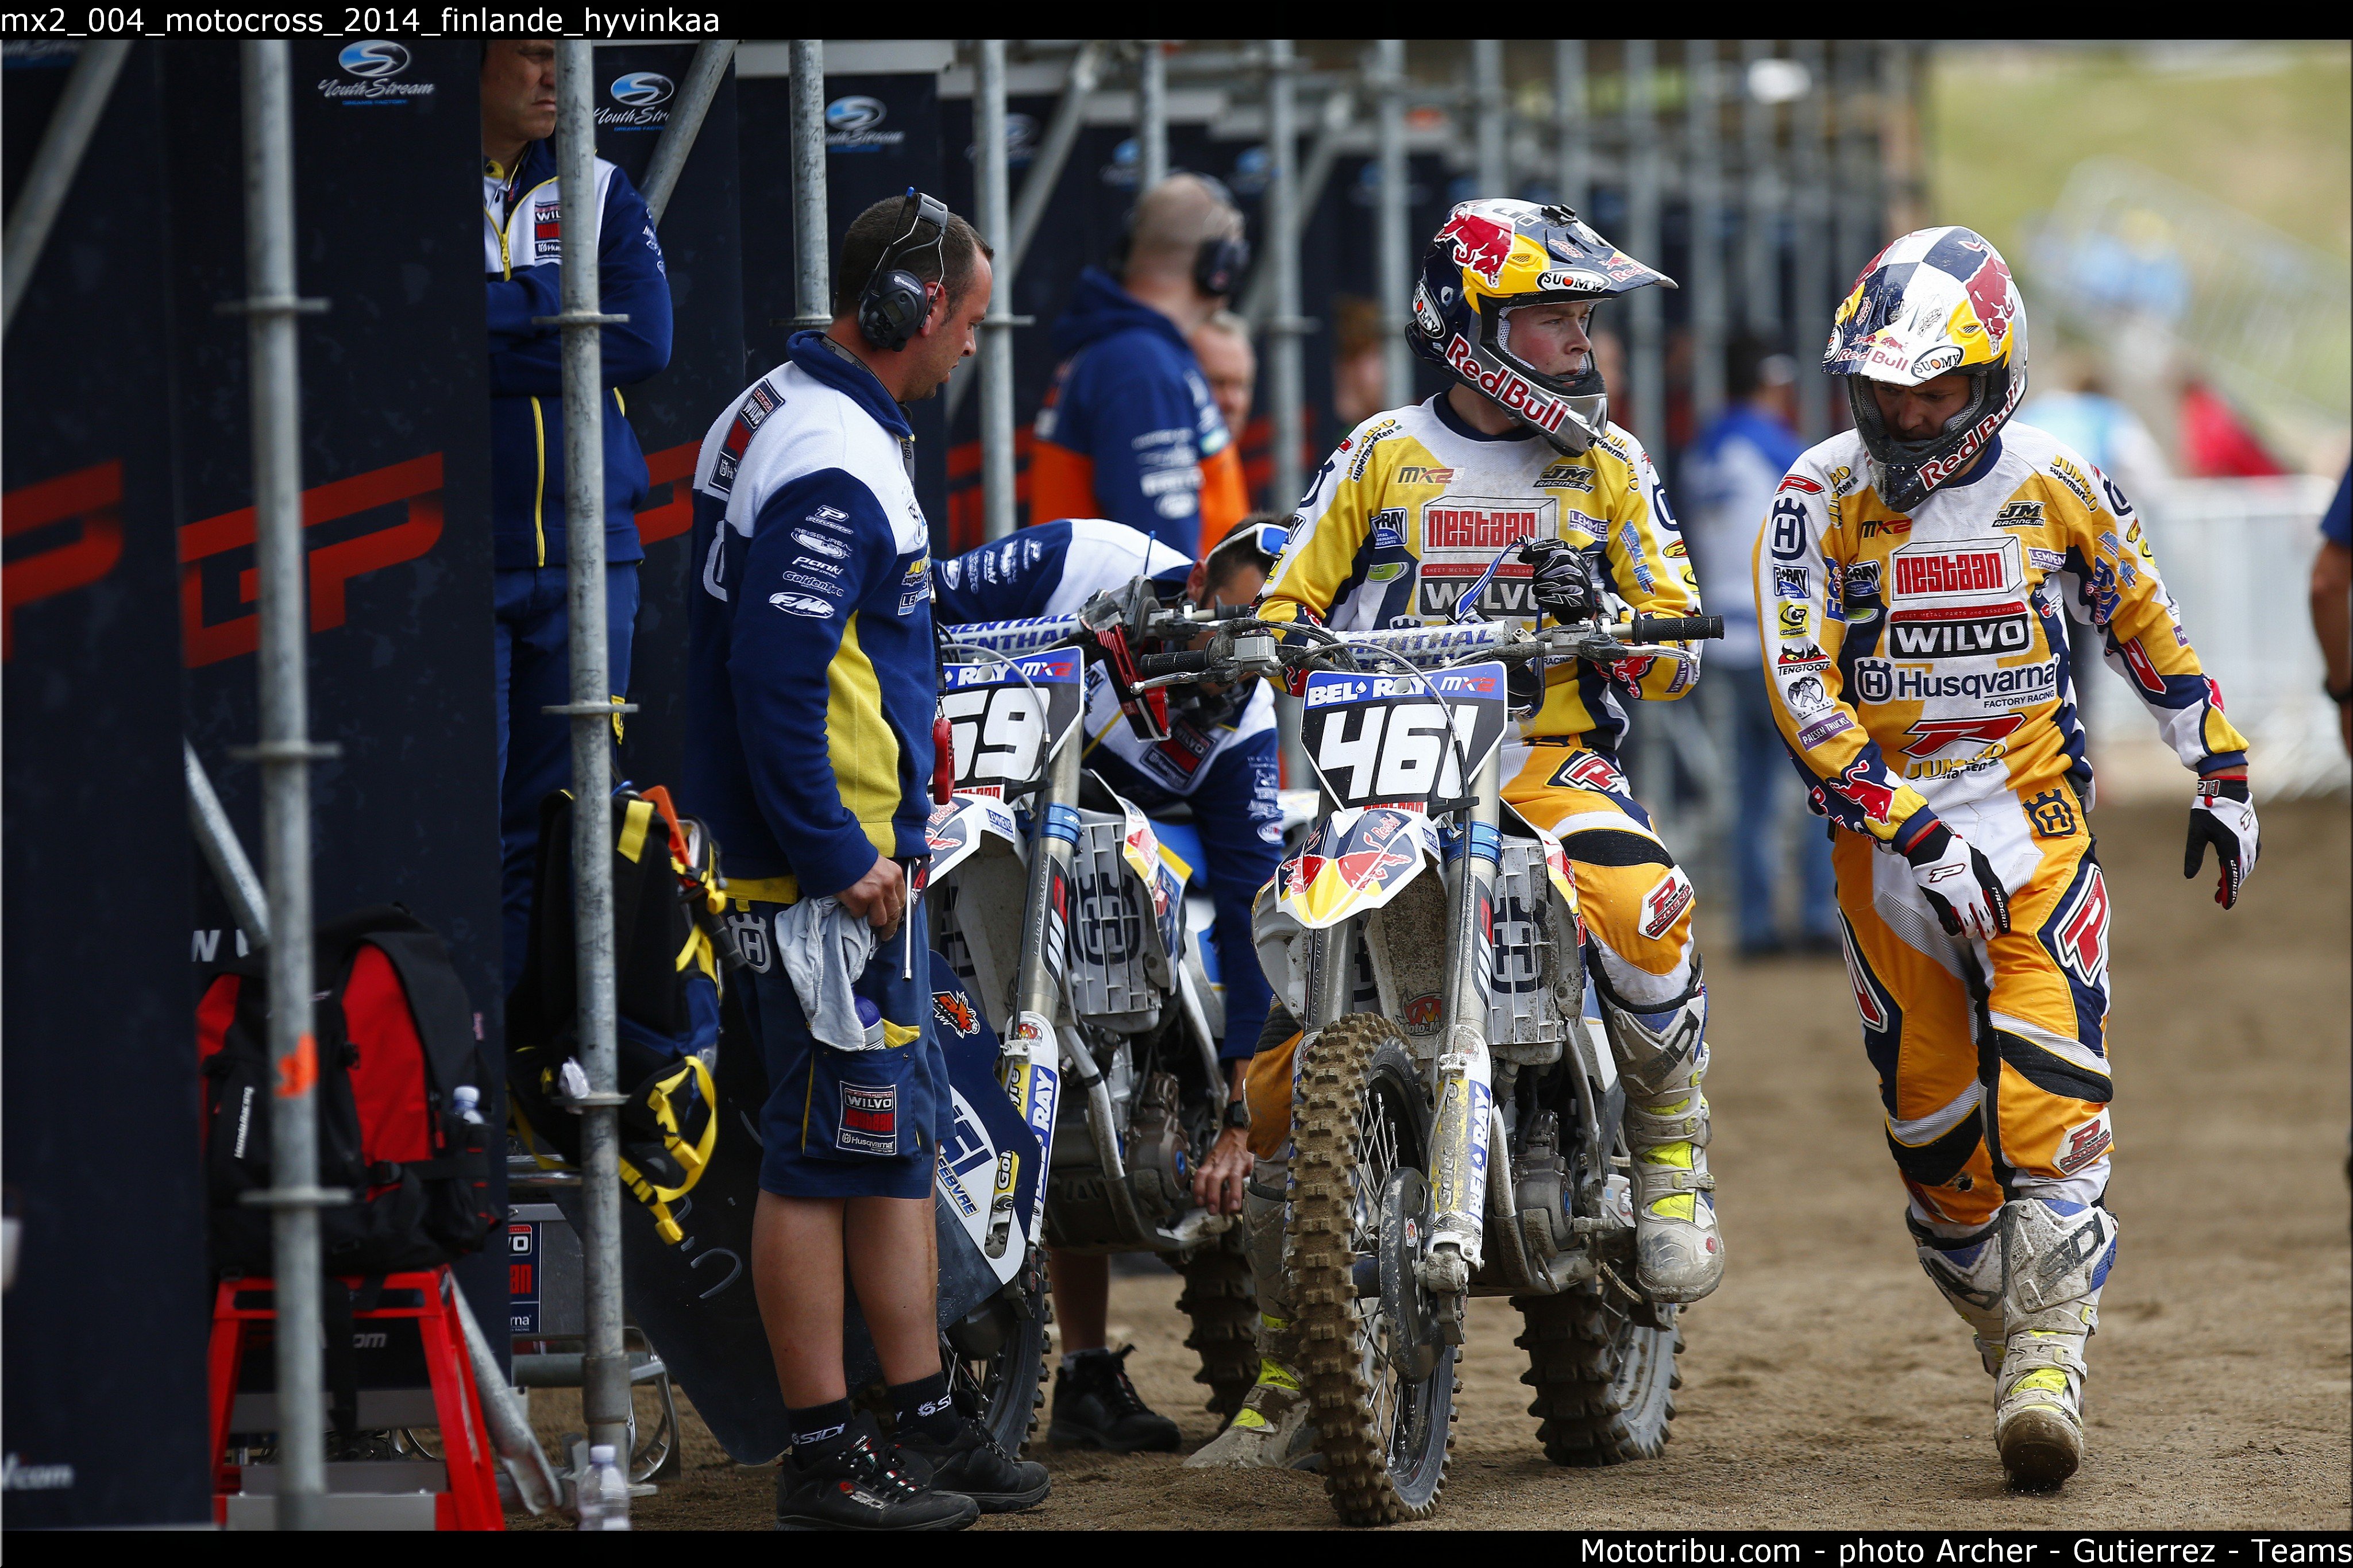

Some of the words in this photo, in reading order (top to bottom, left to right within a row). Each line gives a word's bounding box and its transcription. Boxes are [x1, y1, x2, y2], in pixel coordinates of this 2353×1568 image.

[1543, 271, 1602, 292] SUOMY
[1608, 263, 1648, 283] Red
[1838, 348, 1871, 362] Red
[1872, 350, 1909, 371] Bull
[1914, 354, 1960, 374] SUOMY
[1445, 333, 1511, 397] Red
[1498, 373, 1571, 434] Bull
[1353, 428, 1394, 481] supermarkten
[1916, 429, 1980, 491] Red
[1541, 465, 1595, 481] JM
[1998, 501, 2045, 518] JM
[1429, 510, 1536, 547] nestaan
[1897, 553, 2003, 594] nestaan
[1985, 605, 2022, 615] ASSEMBLIES
[1896, 619, 2025, 653] WILVO
[1543, 656, 1574, 665] RACING
[1899, 663, 2055, 700] Husqvarna
[1307, 682, 1358, 707] BEL
[1984, 697, 2026, 708] FACTORY
[2027, 691, 2055, 704] RACING
[1802, 727, 1827, 745] PAESEN
[1824, 717, 1850, 732] TRUCKS
[1319, 703, 1482, 801] 461
[988, 810, 1013, 832] LEMMENS
[847, 1094, 892, 1109] WILVO
[1032, 1067, 1054, 1133] RAY
[1472, 1084, 1489, 1152] RAY
[851, 1137, 893, 1148] Husqvarna
[1468, 1165, 1485, 1218] BEL
